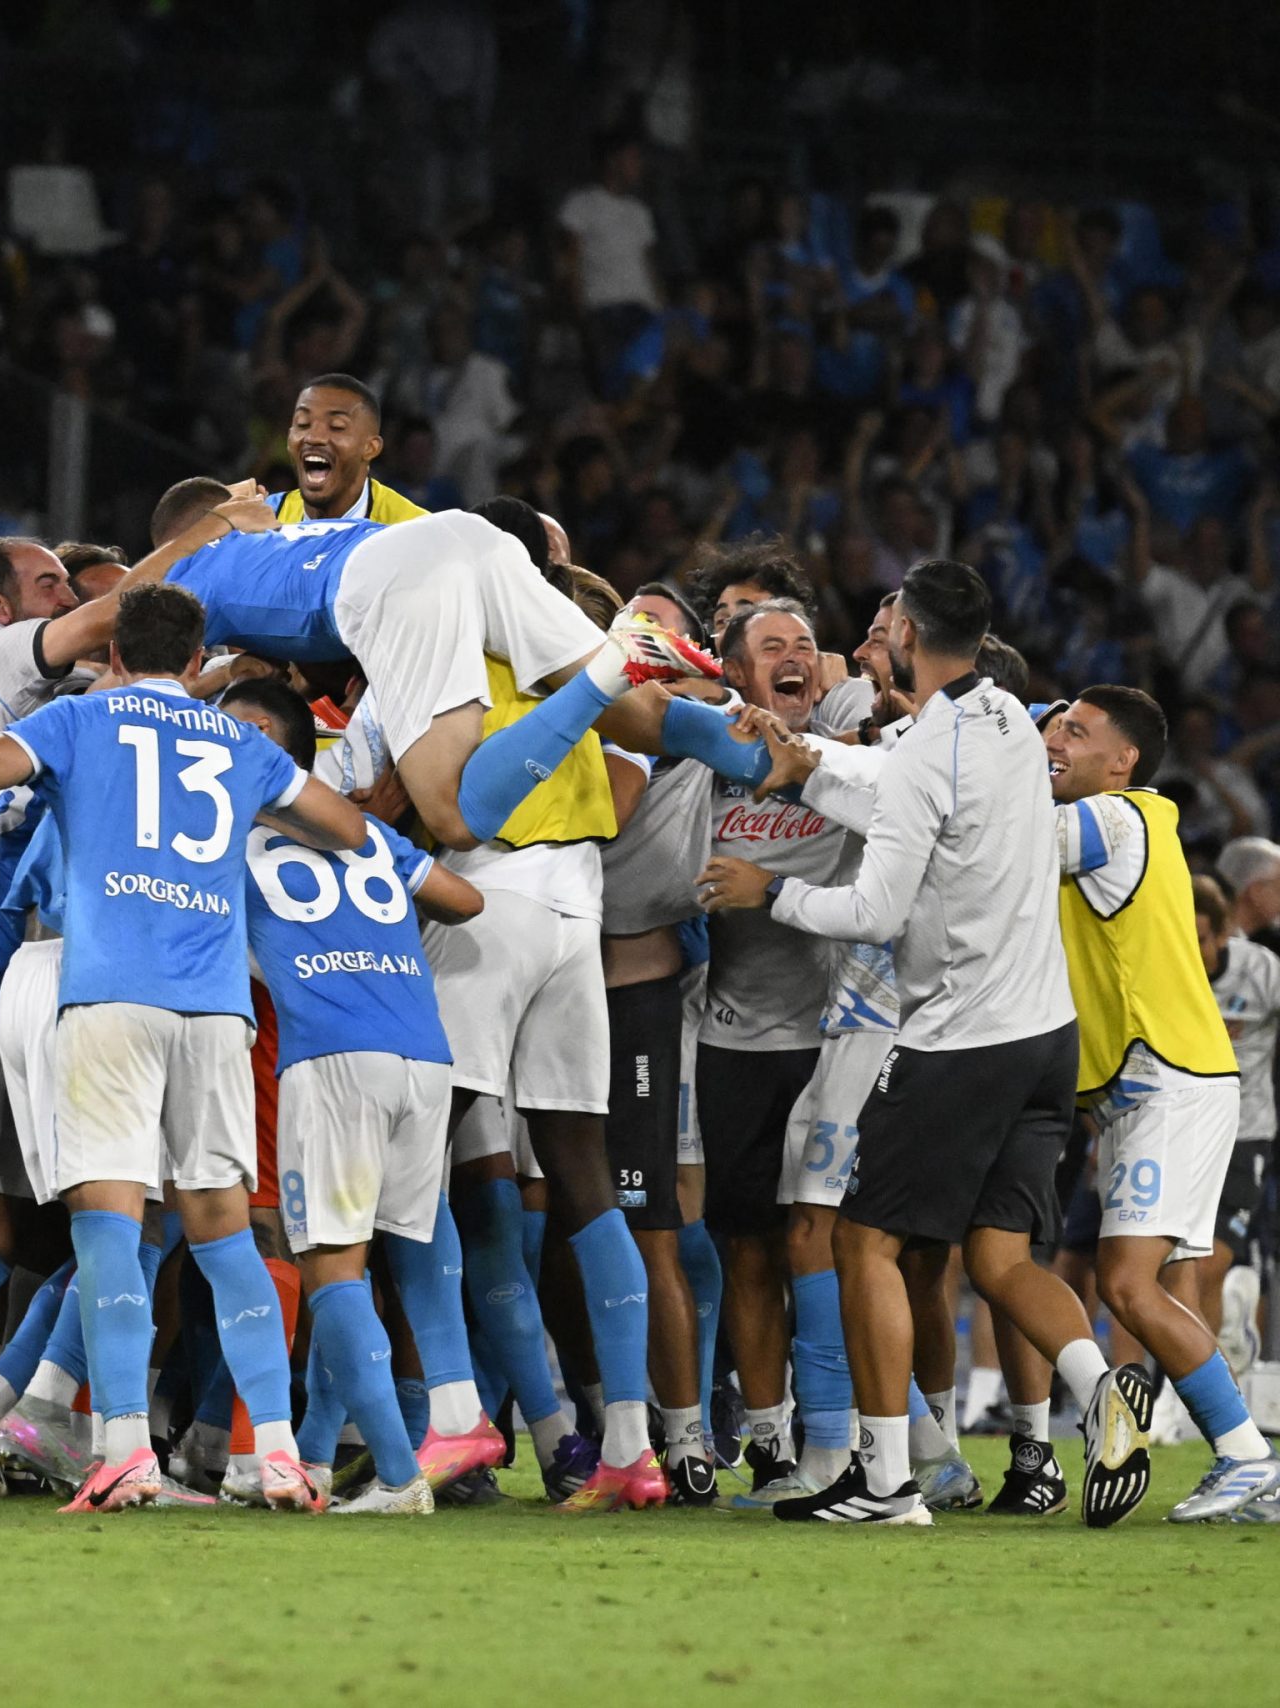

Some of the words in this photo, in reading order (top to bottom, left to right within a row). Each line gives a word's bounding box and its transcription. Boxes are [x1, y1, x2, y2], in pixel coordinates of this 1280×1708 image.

[107, 696, 241, 740] RRAHMANI
[118, 724, 234, 864] 13
[717, 803, 826, 842] Coca-Cola
[245, 820, 408, 924] 68
[104, 871, 231, 915] SORGESANA
[636, 1064, 650, 1097] NAPOLI
[282, 1169, 307, 1222] 8
[1104, 1158, 1161, 1210] 29
[1118, 1209, 1149, 1222] EA7
[97, 1293, 146, 1308] EA7
[221, 1305, 271, 1330] EA7
[604, 1293, 647, 1308] EA7
